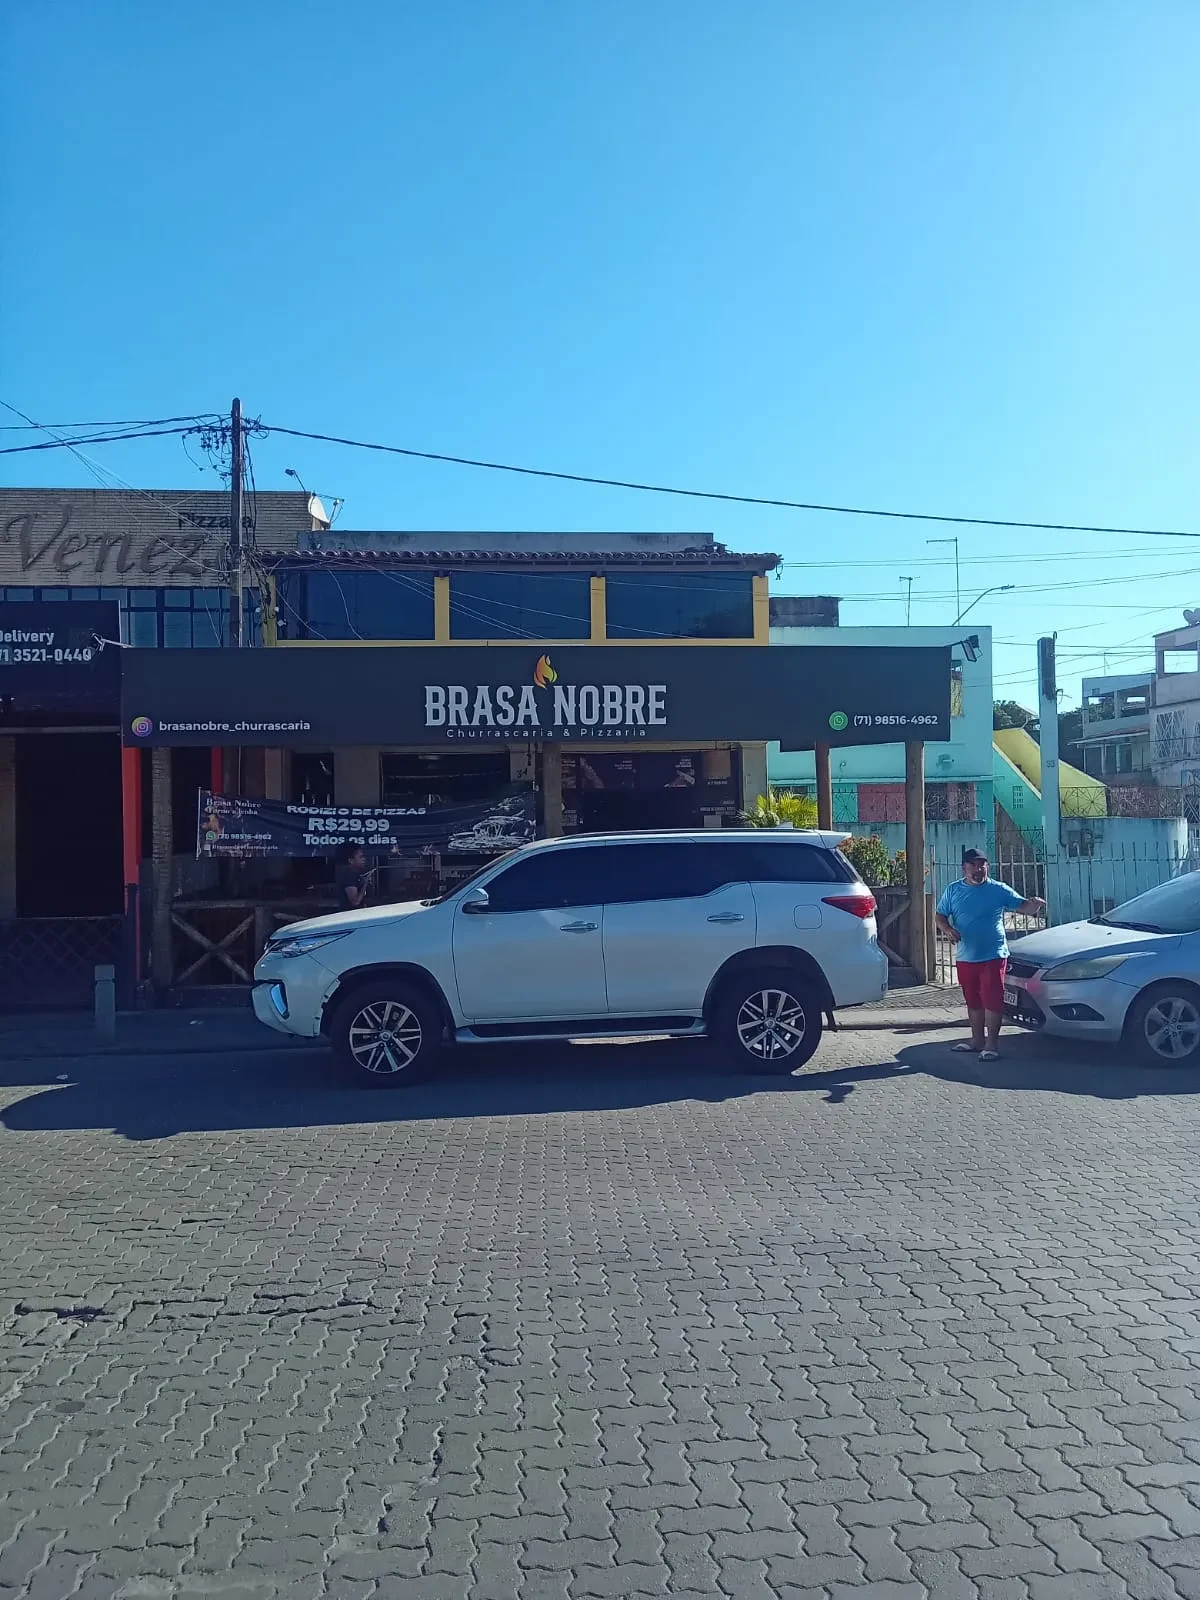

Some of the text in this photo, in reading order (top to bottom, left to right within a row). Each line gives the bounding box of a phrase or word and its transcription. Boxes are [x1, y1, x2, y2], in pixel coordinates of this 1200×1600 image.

[177, 512, 253, 528] Pizzaa
[13, 648, 92, 662] 3521-0440
[424, 684, 668, 726] BRASA NOBRE
[158, 719, 311, 732] brasanobre_churrascaria
[853, 715, 938, 727] (71) 98516-4962
[446, 728, 647, 738] Churrascaria & Pizzaria
[234, 799, 262, 808] Nobre
[352, 808, 372, 816] DE
[374, 807, 427, 816] PIZZAS
[308, 817, 390, 833] R$29,99
[302, 833, 345, 846] Todos
[368, 833, 398, 845] dias
